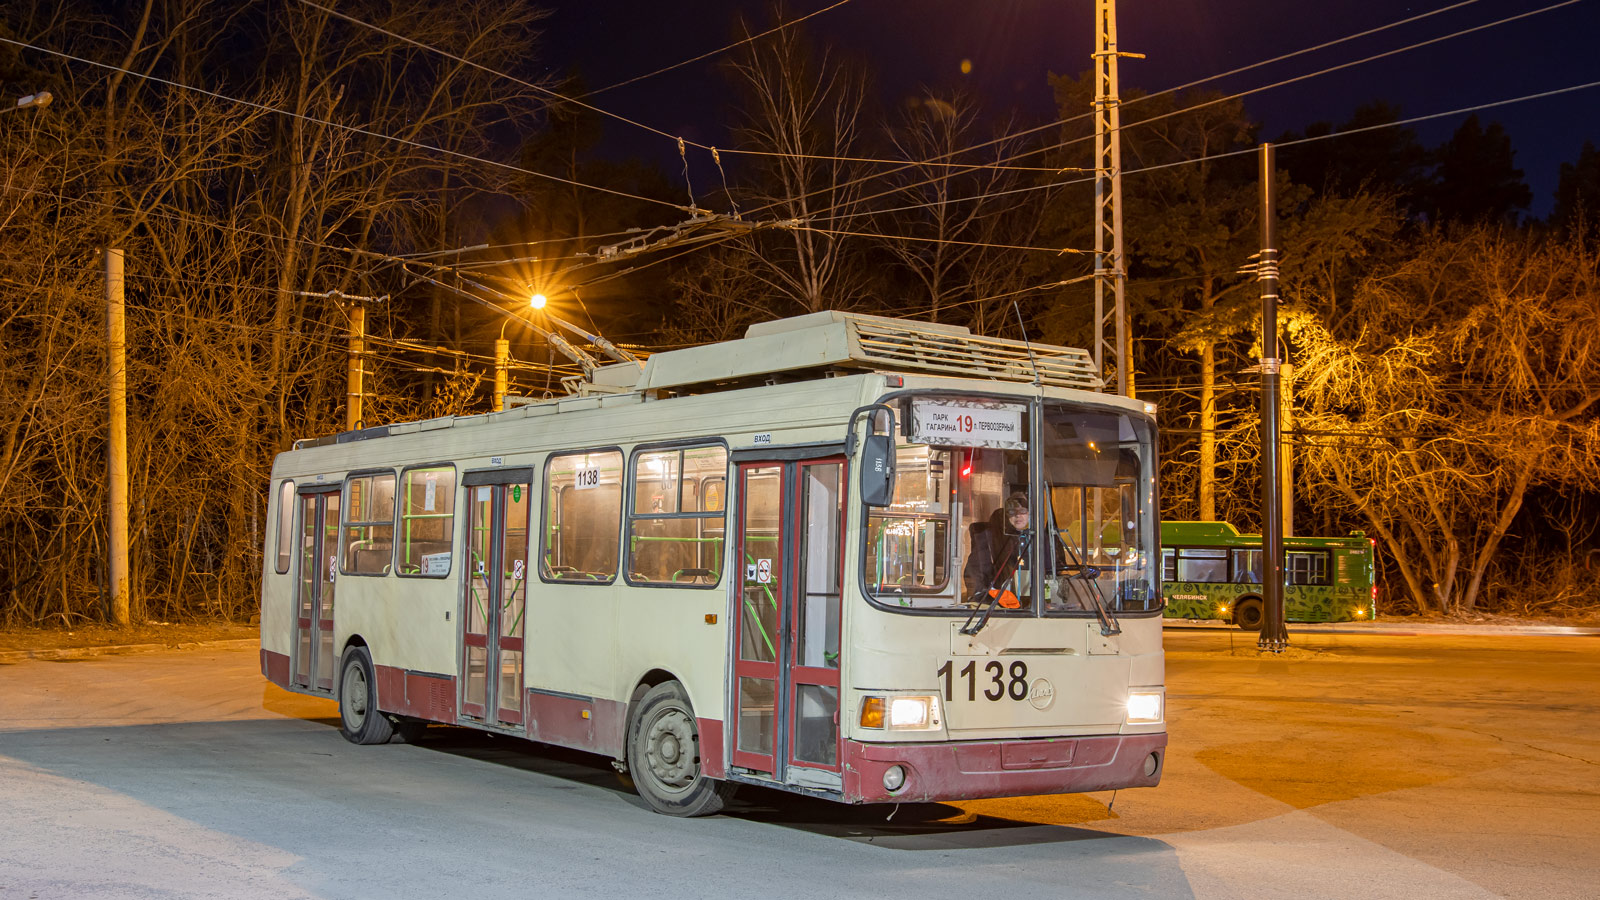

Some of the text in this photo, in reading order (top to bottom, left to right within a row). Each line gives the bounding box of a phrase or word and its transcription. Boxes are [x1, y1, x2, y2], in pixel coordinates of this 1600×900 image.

[933, 413, 949, 421] ПАРК
[956, 414, 973, 433] 19
[926, 423, 957, 431] ГАГАРИНА
[979, 421, 1014, 432] ПЕРВООЗЕРНЫЙ
[754, 434, 771, 443] ВХОД
[577, 469, 599, 487] 1138
[422, 556, 429, 574] 19
[937, 660, 1029, 702] 1138
